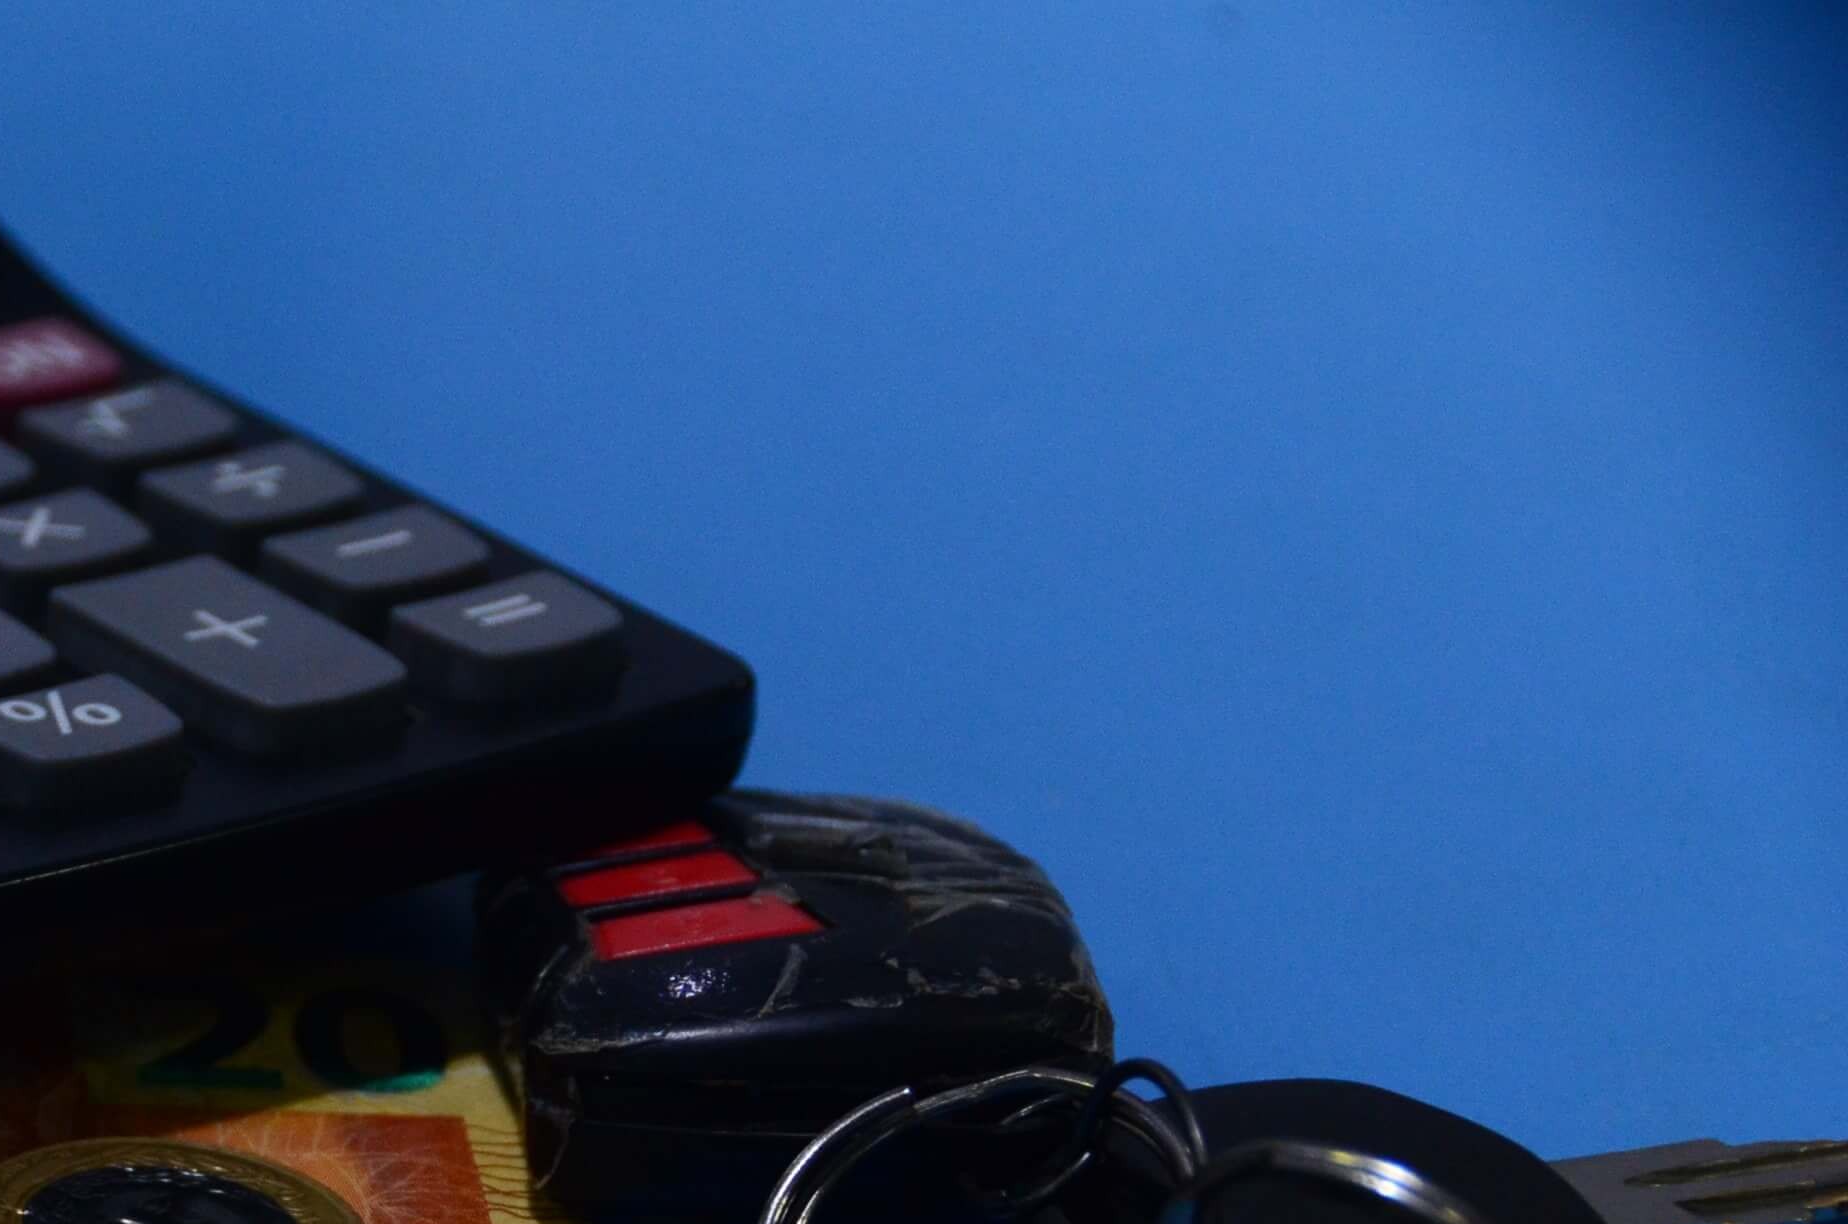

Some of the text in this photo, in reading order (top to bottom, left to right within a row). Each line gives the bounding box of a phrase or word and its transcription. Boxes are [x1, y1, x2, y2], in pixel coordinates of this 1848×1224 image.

[463, 593, 547, 626] =
[183, 610, 268, 647] +
[127, 977, 449, 1091] 20
